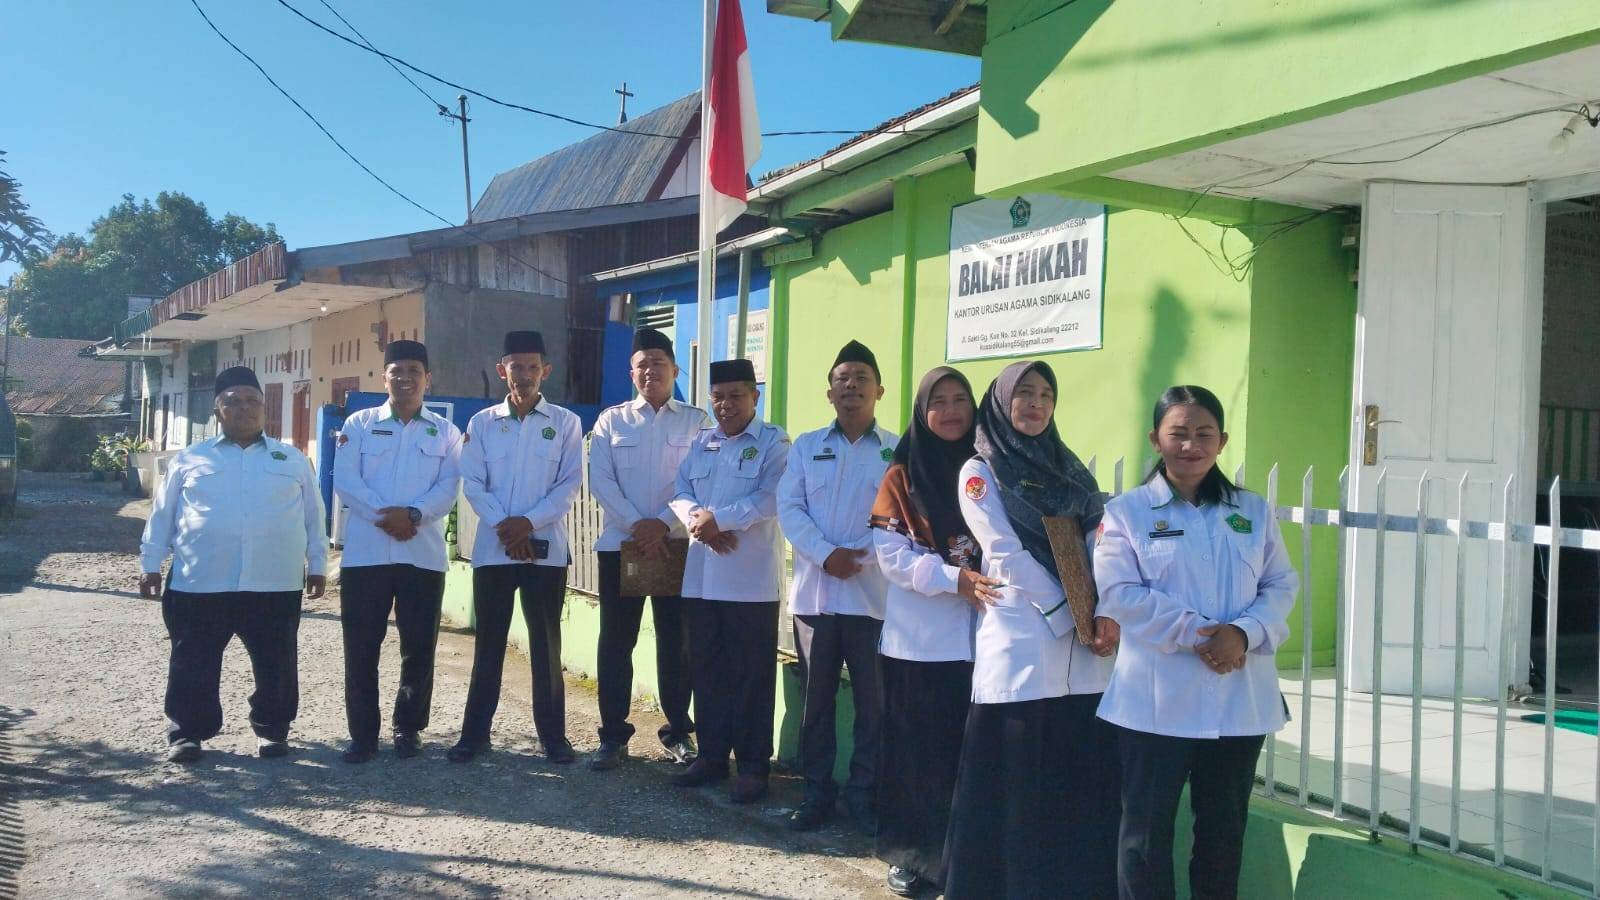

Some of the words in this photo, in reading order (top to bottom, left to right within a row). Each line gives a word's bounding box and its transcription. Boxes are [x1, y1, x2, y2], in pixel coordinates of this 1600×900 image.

[999, 234, 1020, 245] AGAMA
[958, 254, 1012, 297] BALAI
[1015, 238, 1088, 287] NIKAH
[954, 306, 980, 319] KANTOR
[981, 301, 1009, 316] URUSAN
[1010, 297, 1038, 311] AGAMA
[1040, 289, 1091, 306] SIDIKALANG
[1001, 330, 1009, 338] No.
[1018, 328, 1028, 337] Kel.
[1030, 326, 1059, 335] Sidikalang
[1060, 322, 1079, 332] 22212
